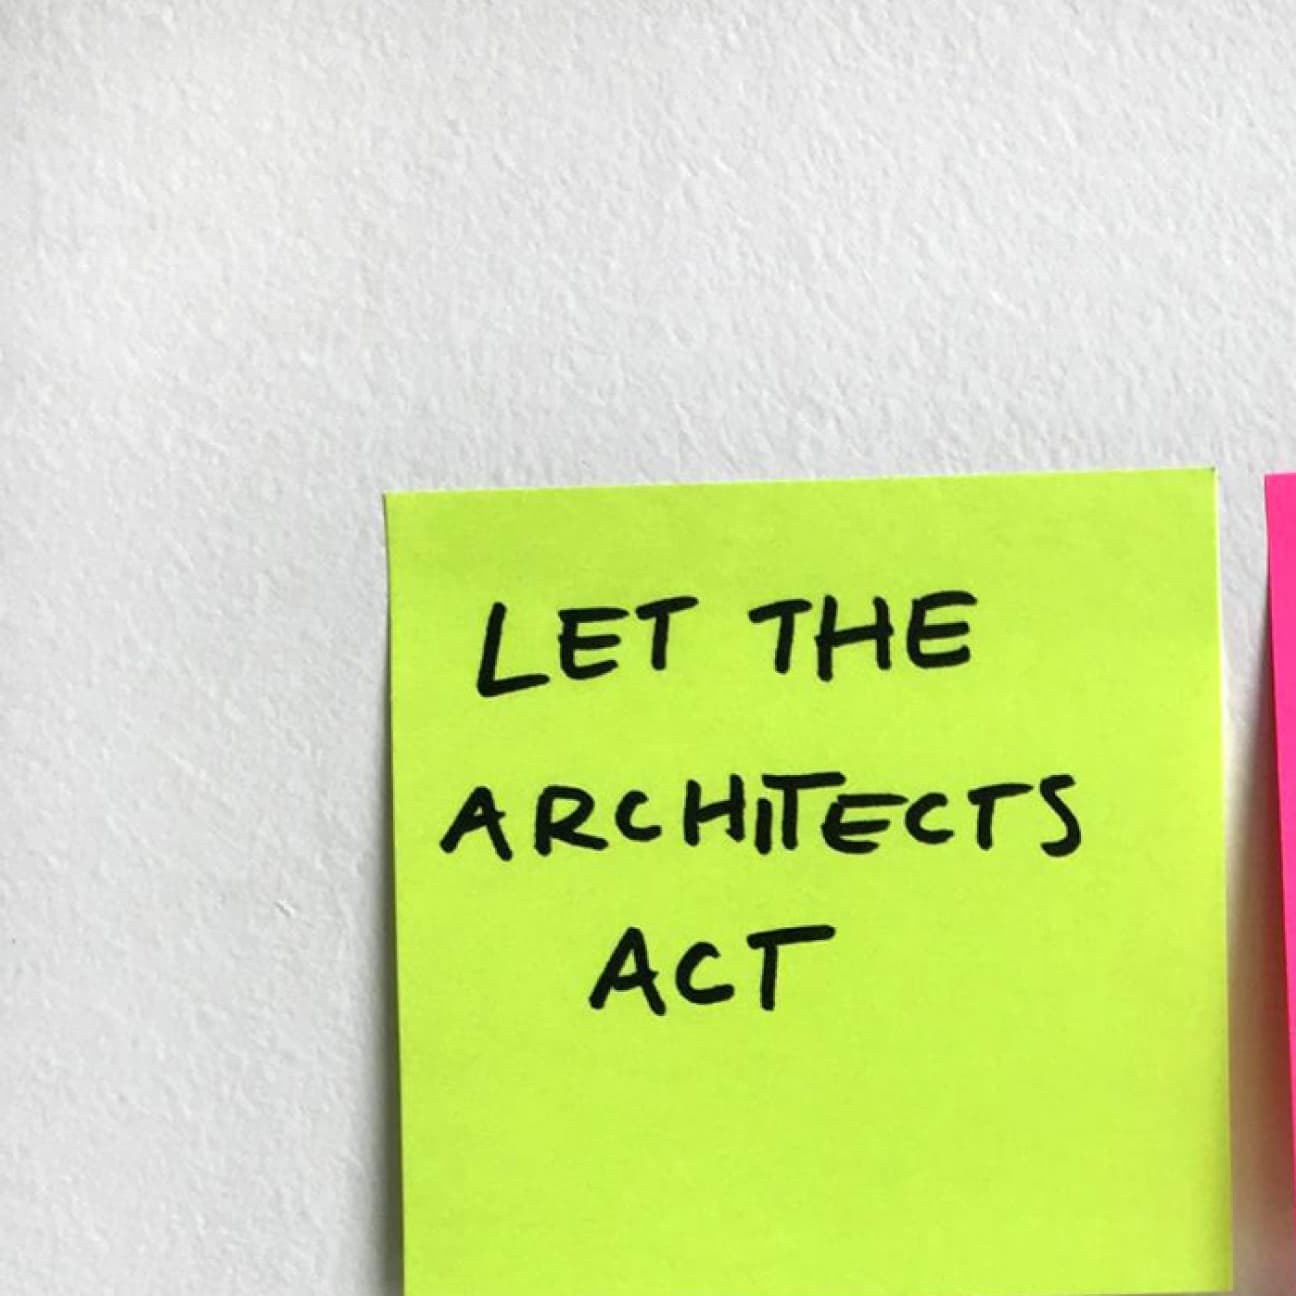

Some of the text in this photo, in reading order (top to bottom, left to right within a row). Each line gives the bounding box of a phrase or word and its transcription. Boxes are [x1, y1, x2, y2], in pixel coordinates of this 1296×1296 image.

[476, 590, 978, 698] LET THE
[439, 771, 1082, 862] ARCHITECTS
[588, 924, 836, 1017] ACT
